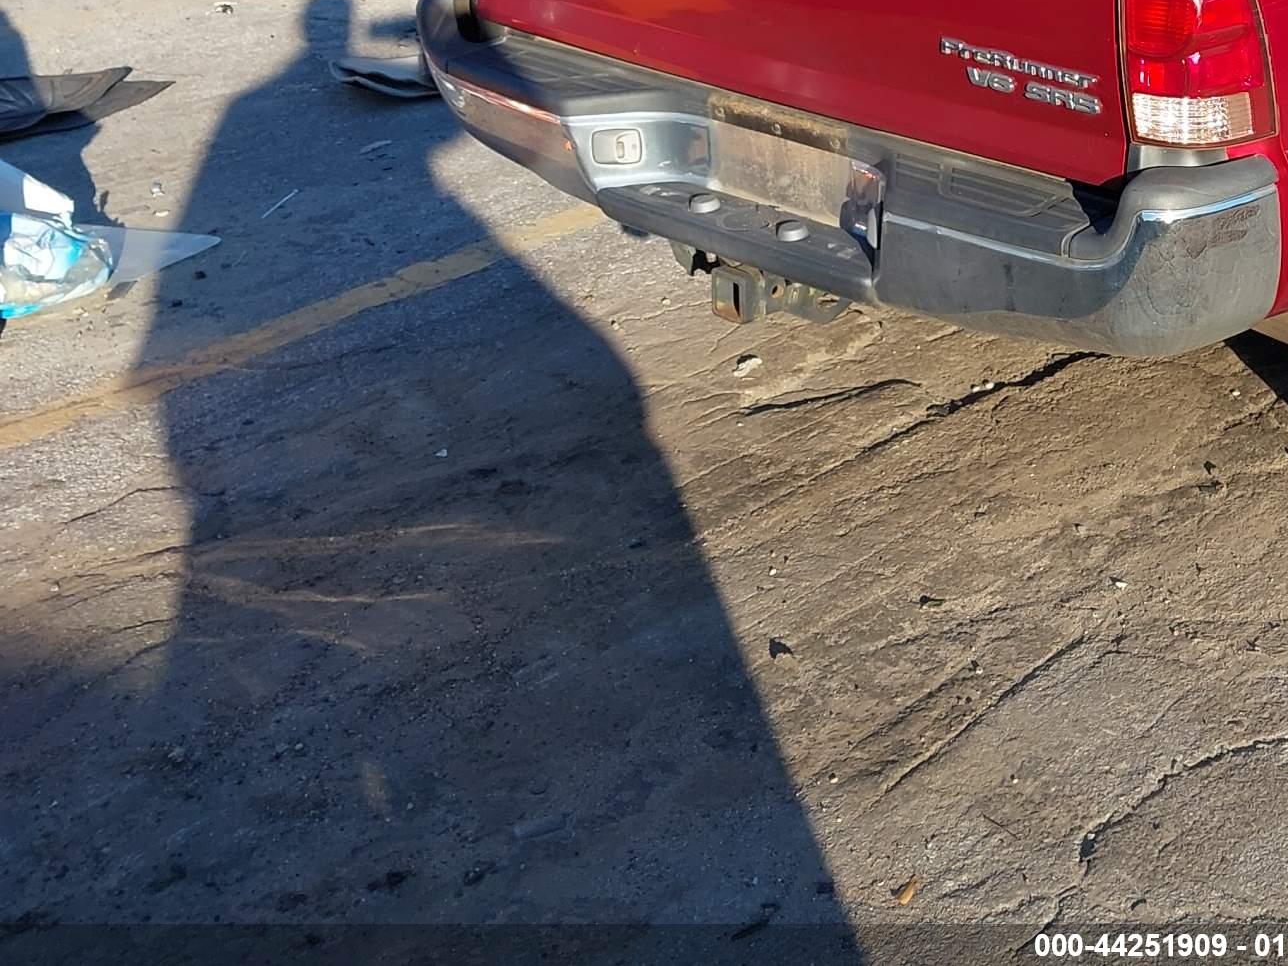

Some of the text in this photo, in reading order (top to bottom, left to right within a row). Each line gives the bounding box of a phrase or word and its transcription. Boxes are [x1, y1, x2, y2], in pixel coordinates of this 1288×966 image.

[940, 36, 1101, 89] PreRunner
[966, 66, 1103, 115] V6 SR5
